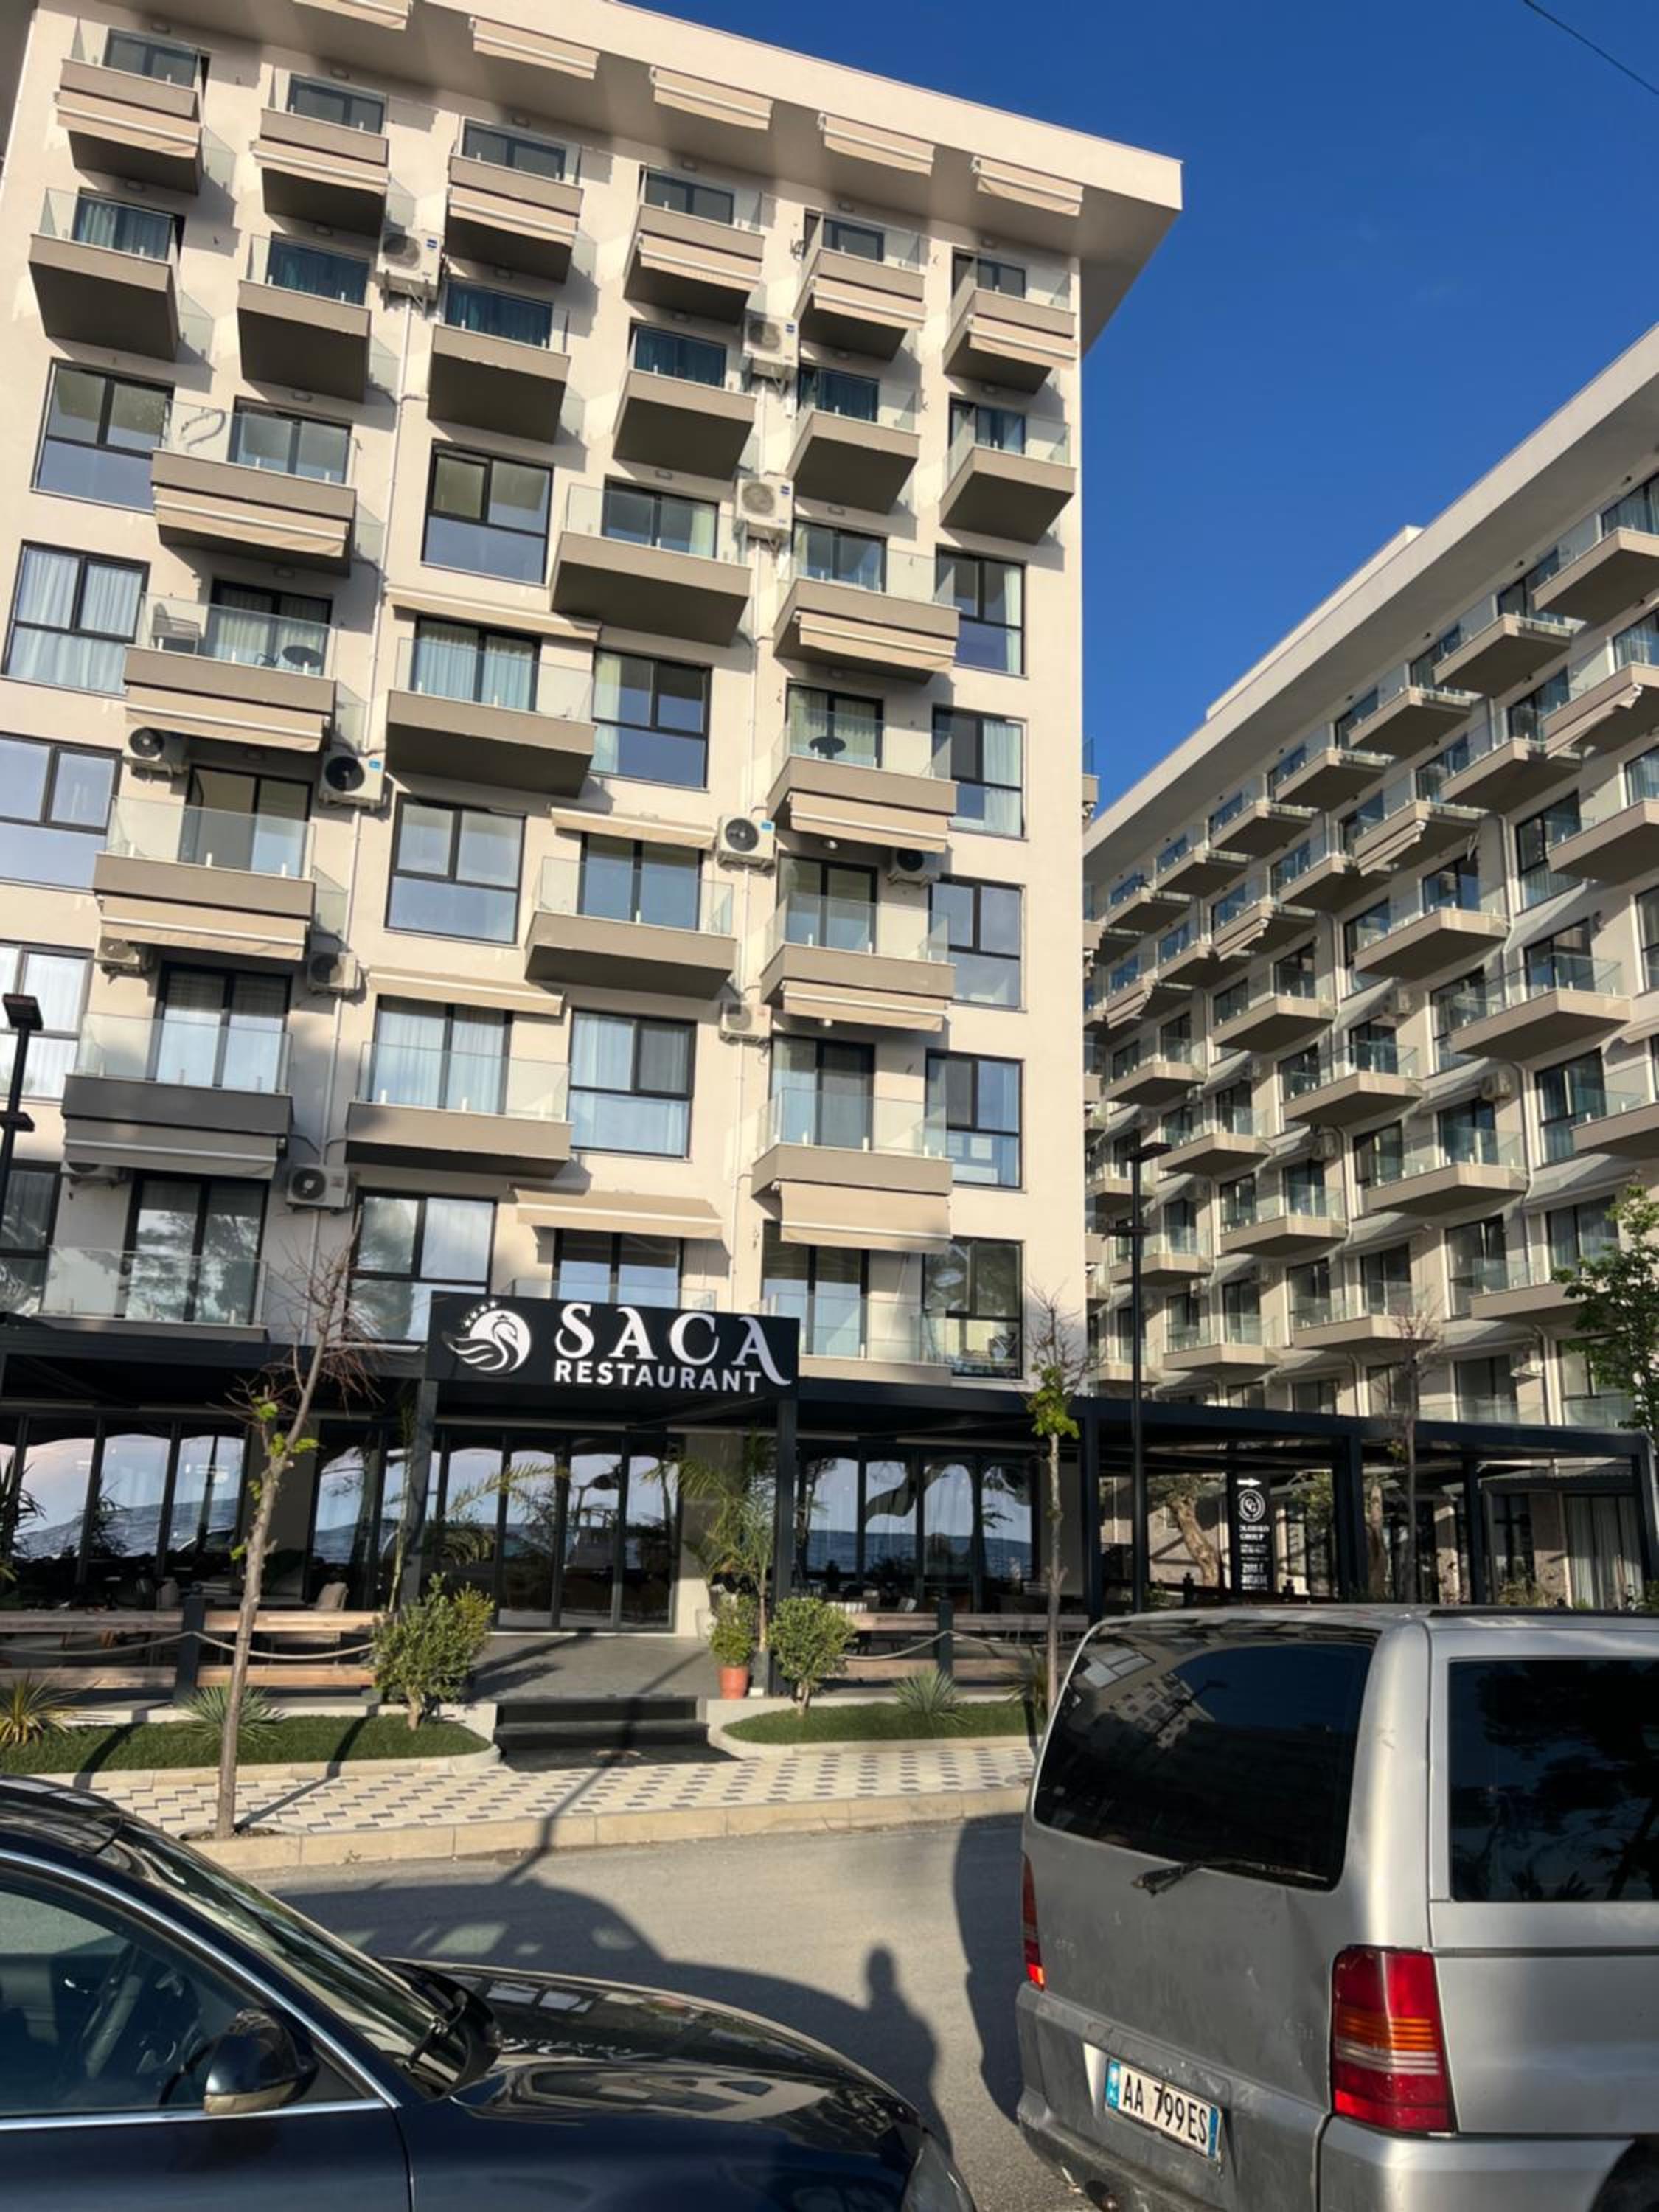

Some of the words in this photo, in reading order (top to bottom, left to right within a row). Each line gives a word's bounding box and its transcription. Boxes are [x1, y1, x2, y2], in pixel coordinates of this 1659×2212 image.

[554, 1303, 791, 1385] SACA
[554, 1360, 762, 1393] RESTAURANT
[1123, 2074, 1144, 2114] AA
